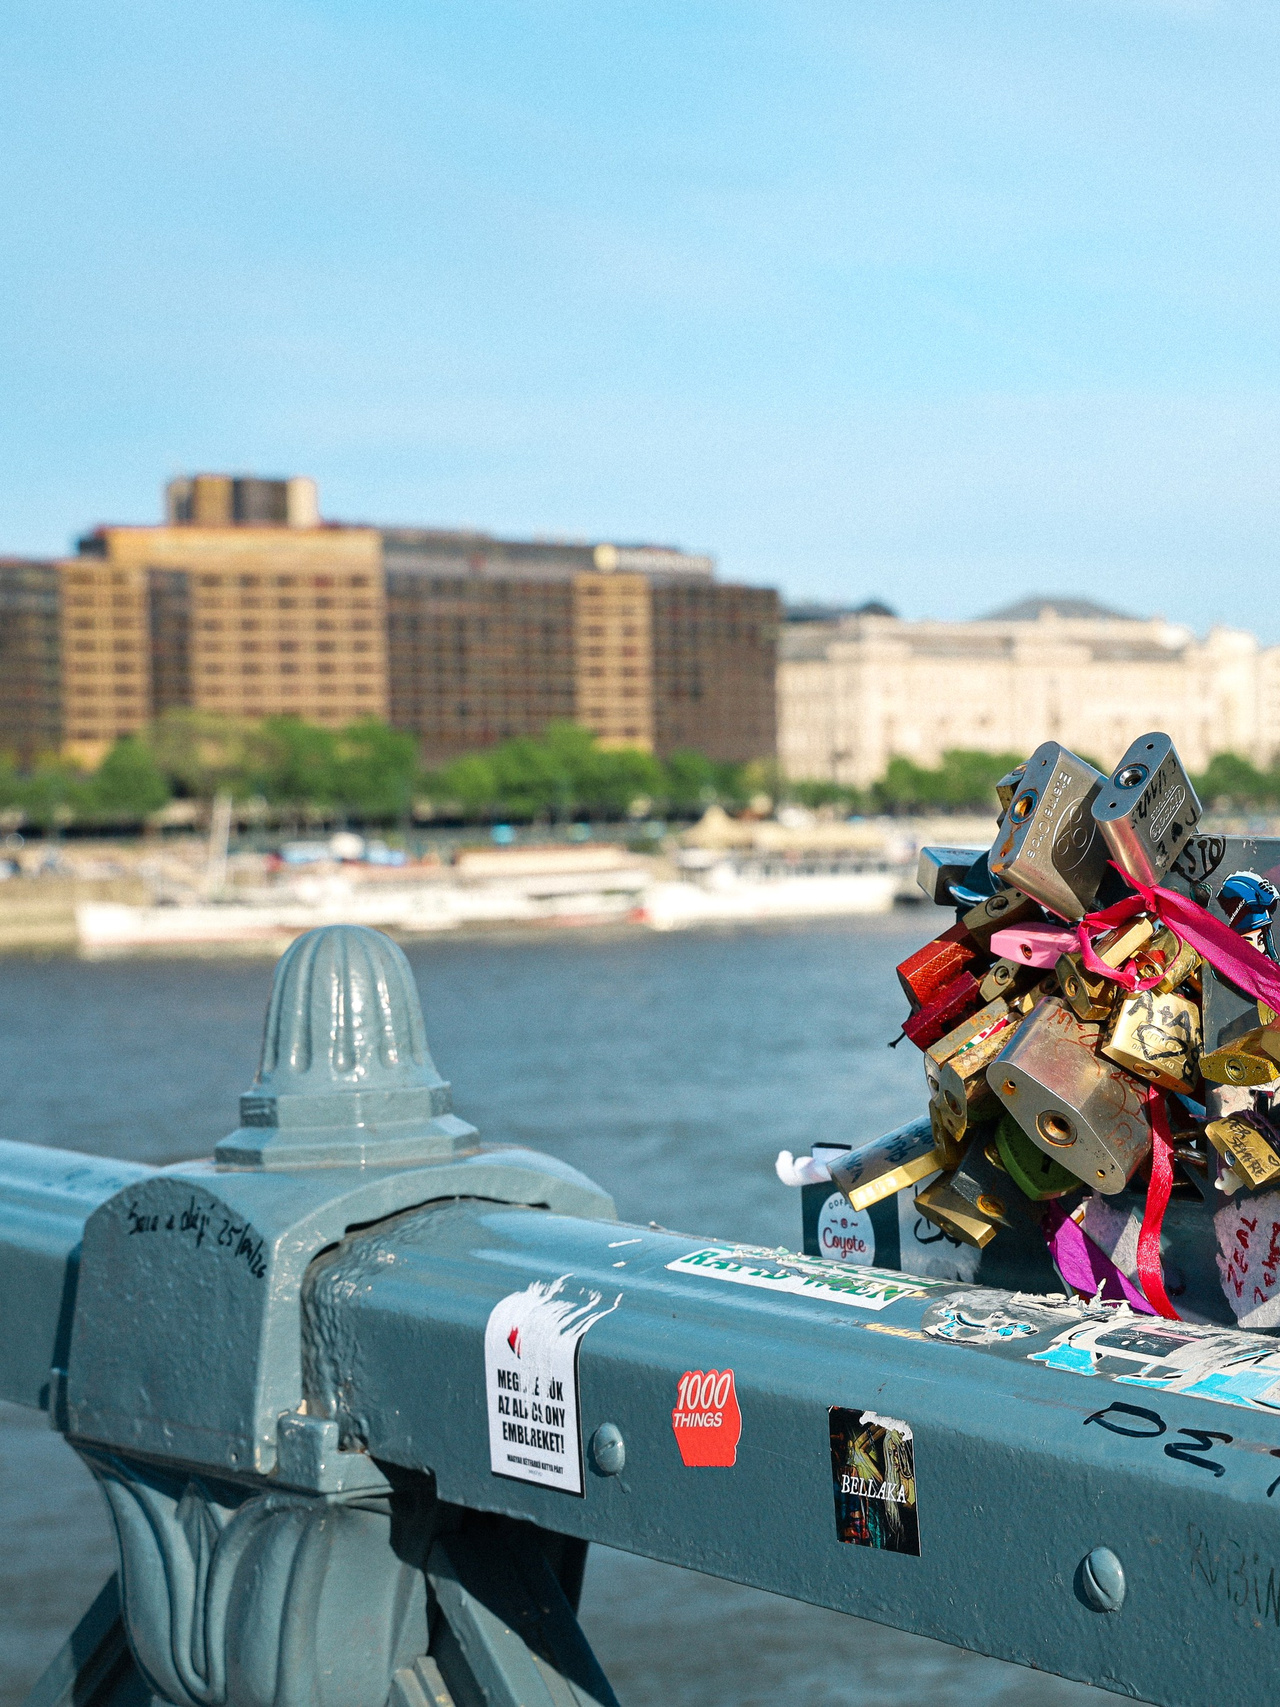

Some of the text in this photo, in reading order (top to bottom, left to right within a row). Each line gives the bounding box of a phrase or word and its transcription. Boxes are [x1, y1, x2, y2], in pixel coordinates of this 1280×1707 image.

[823, 1227, 867, 1259] Coyote
[498, 1395, 511, 1416] AZ
[678, 1373, 731, 1411] 1000
[673, 1412, 723, 1428] THINGS
[841, 1474, 908, 1504] BELLAKA
